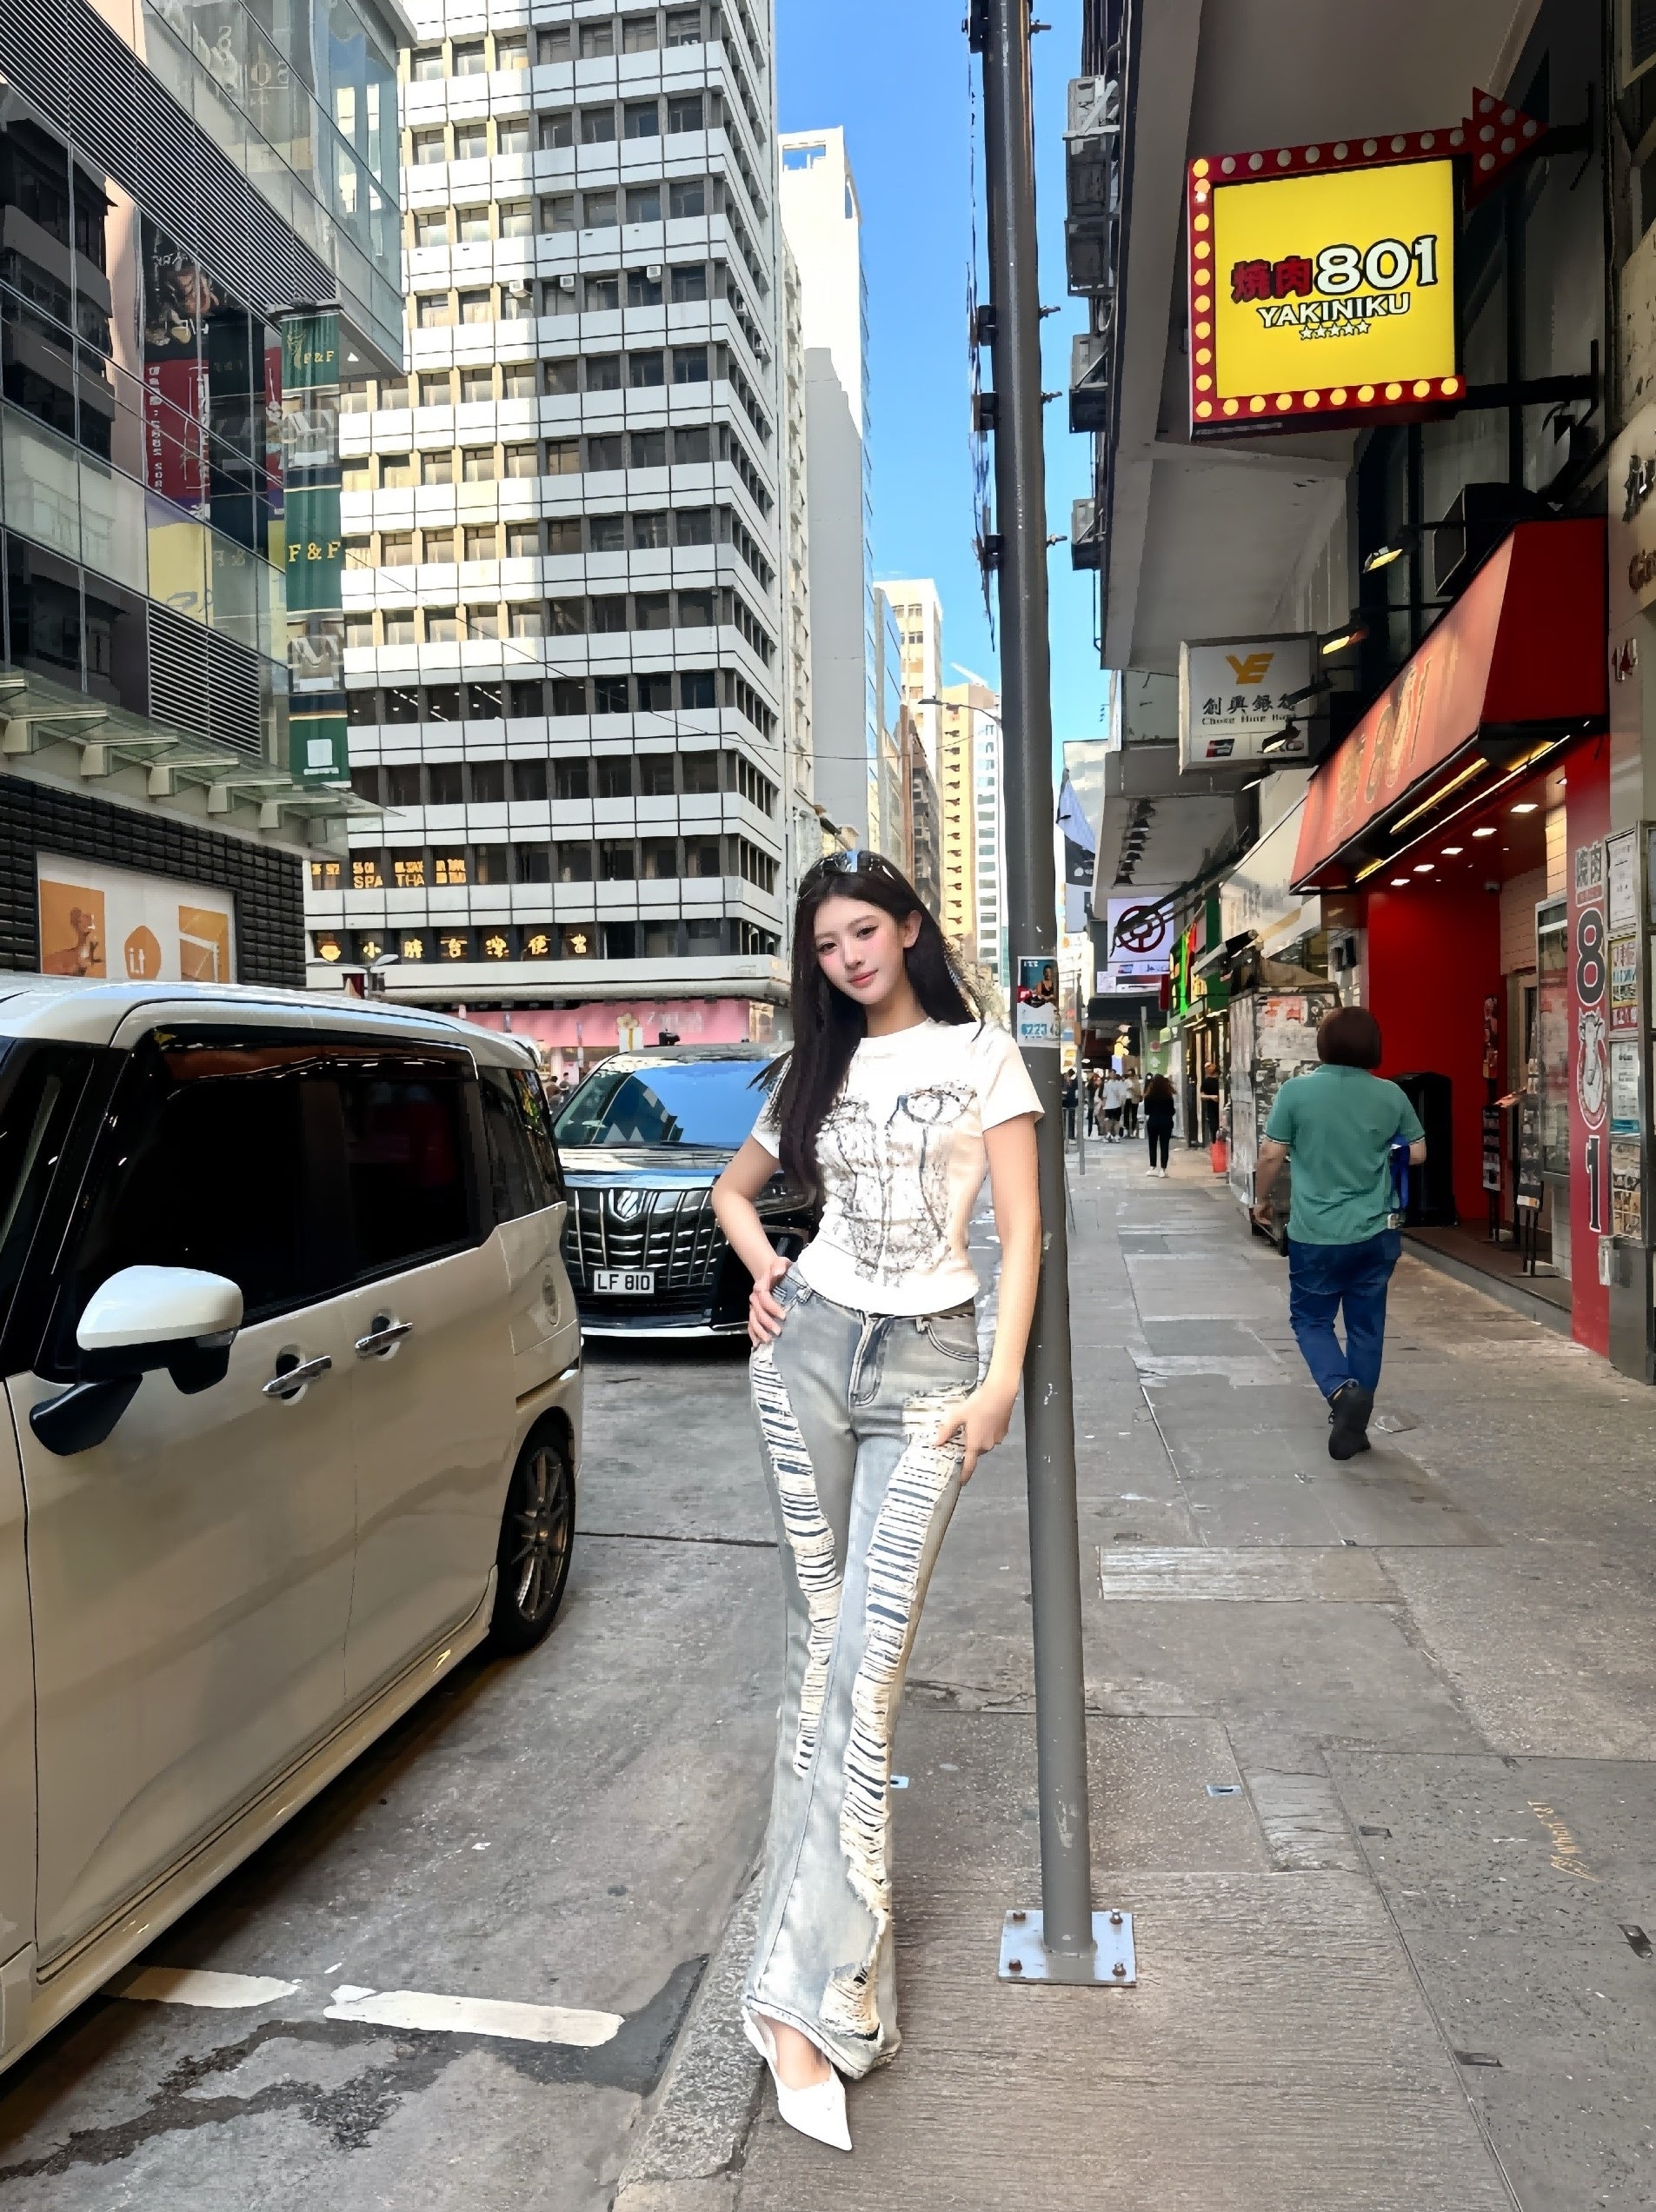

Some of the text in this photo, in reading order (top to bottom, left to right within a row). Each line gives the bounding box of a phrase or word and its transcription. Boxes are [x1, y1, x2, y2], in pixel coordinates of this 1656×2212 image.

[1314, 235, 1437, 296] 801
[1257, 292, 1410, 329] YAKINIKU
[289, 541, 341, 562] F & F
[353, 874, 383, 889] SPA
[597, 1273, 650, 1291] LF 810
